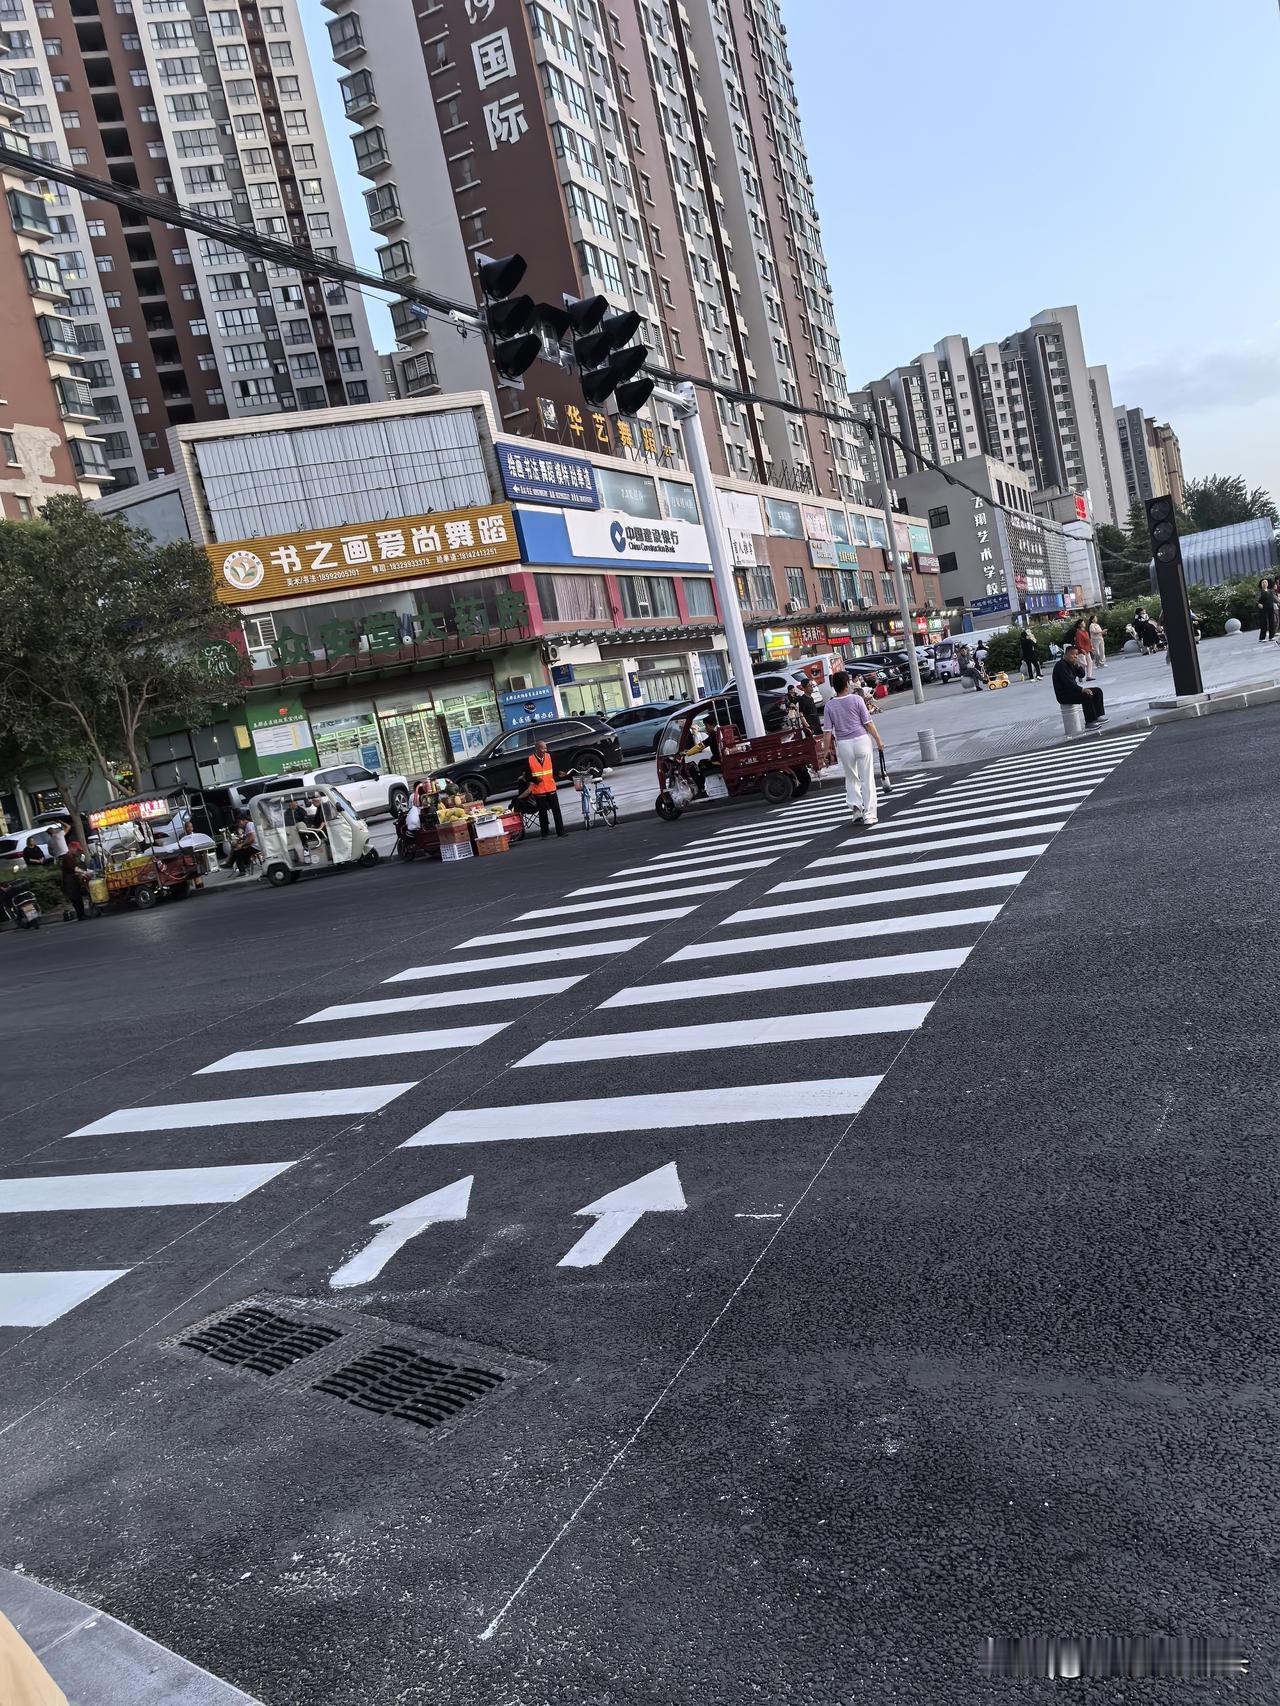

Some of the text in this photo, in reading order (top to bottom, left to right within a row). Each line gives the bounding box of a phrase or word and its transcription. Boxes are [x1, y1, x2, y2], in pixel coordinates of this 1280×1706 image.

[565, 404, 657, 454] 华艺舞蹈
[507, 452, 526, 479] 绘画
[524, 456, 541, 481] 书法
[270, 515, 508, 574] 书之画爱尚舞蹈
[625, 526, 680, 546] 中国建设银行
[274, 589, 529, 668] 众安堂大药房
